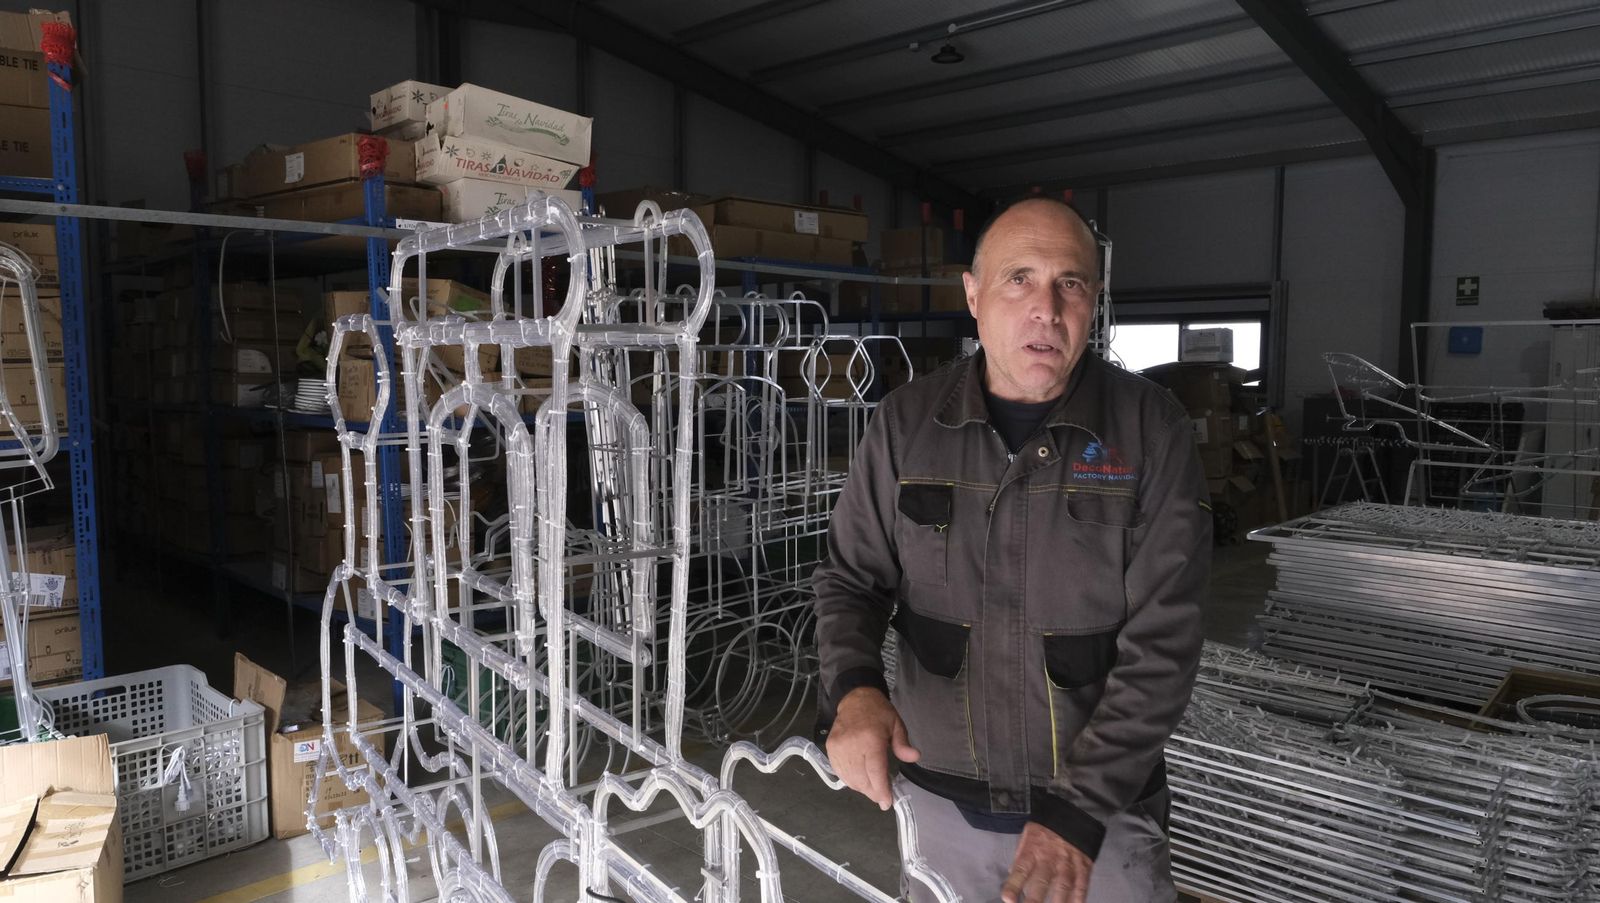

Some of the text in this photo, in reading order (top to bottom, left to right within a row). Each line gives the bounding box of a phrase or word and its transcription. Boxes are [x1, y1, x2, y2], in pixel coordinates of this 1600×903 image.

[23, 58, 38, 71] TIE
[497, 103, 517, 119] Tiras
[524, 113, 566, 132] Navidad
[12, 141, 29, 153] TIE
[456, 157, 491, 173] TIRAS
[504, 166, 560, 183] NAVIDAD
[494, 192, 517, 205] Tiras
